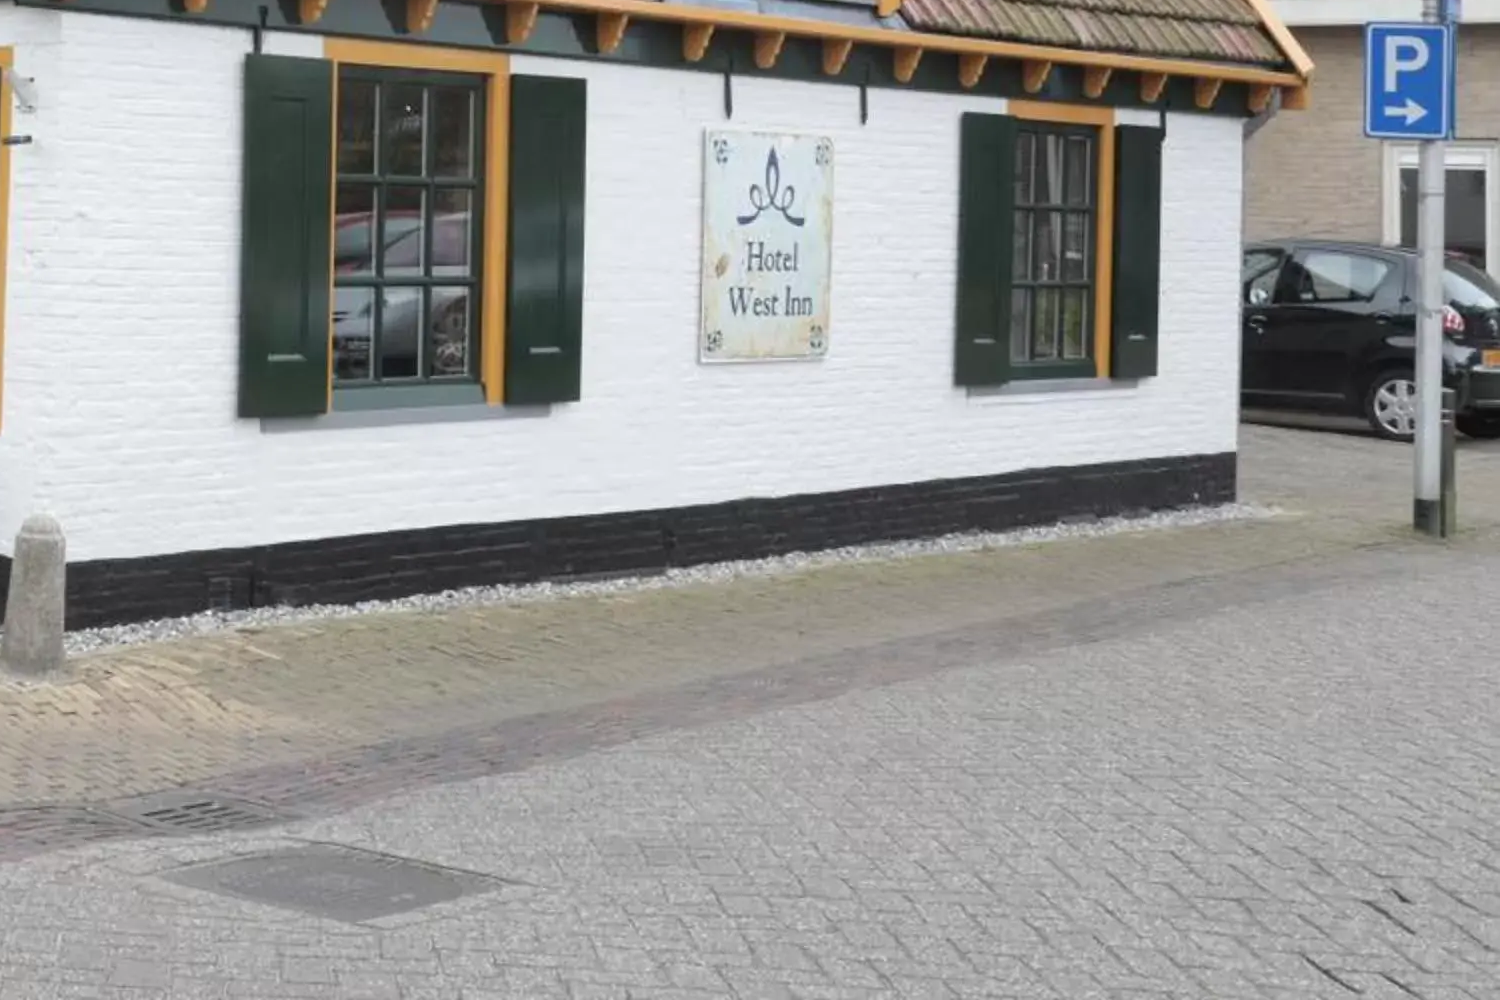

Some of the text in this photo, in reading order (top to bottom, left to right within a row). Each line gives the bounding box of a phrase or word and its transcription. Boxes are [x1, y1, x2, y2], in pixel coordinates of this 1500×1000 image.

[1384, 34, 1429, 93] P
[746, 240, 799, 273] Hotel
[729, 284, 813, 317] West Inn
